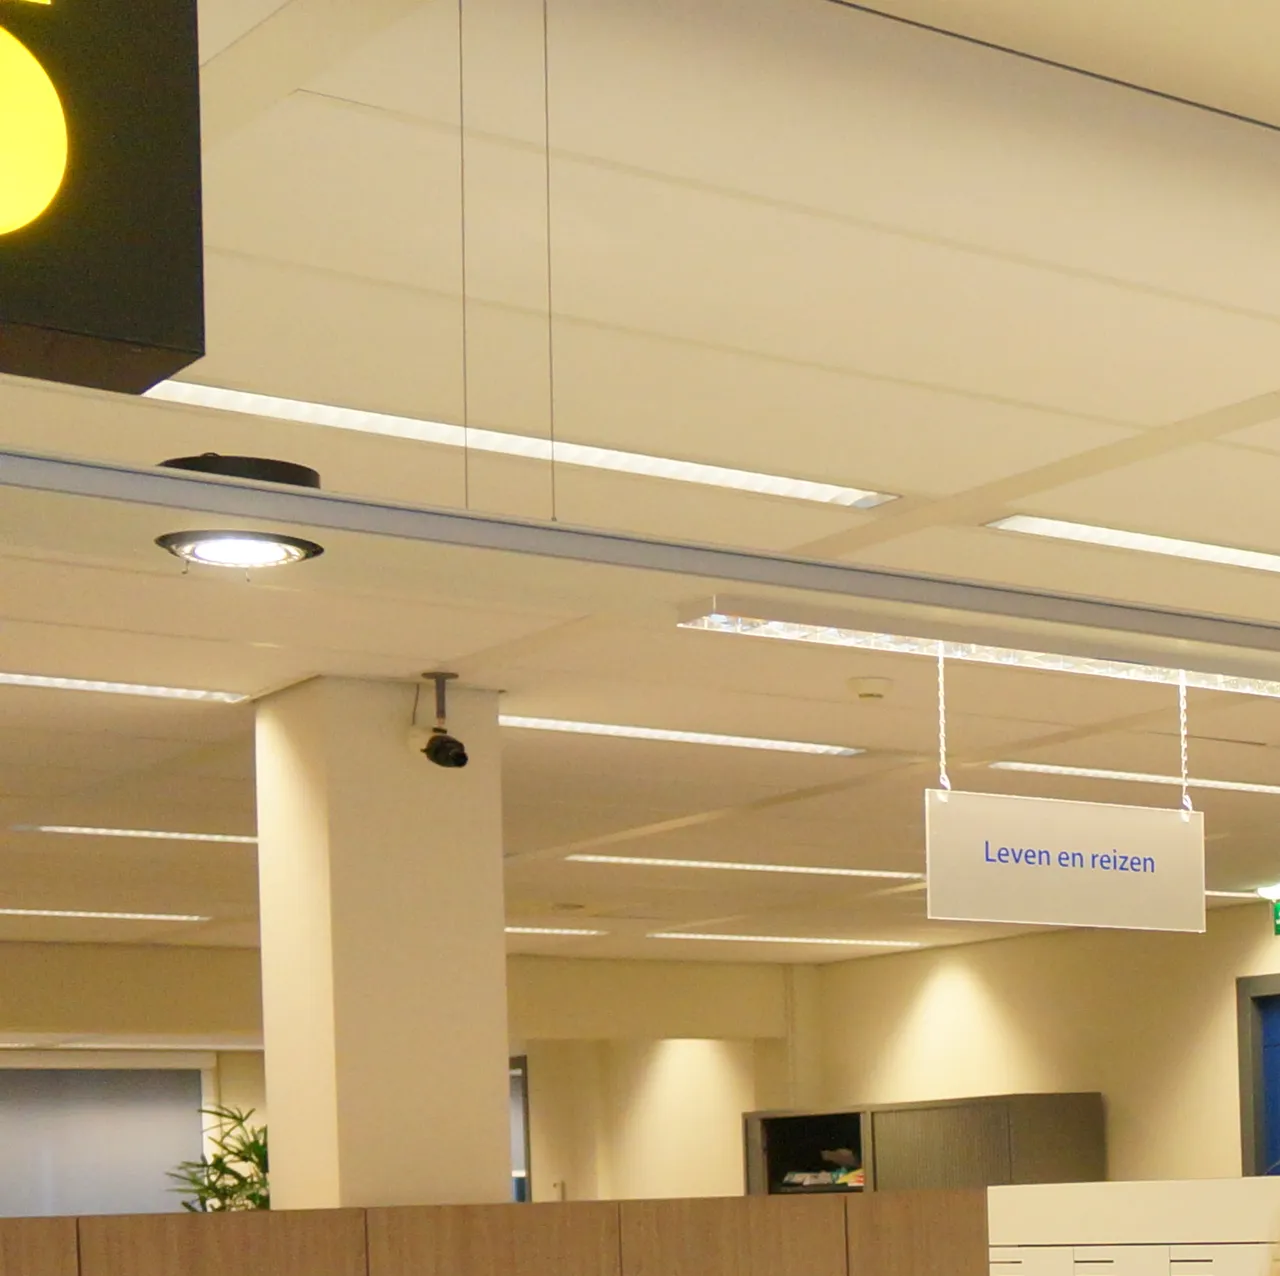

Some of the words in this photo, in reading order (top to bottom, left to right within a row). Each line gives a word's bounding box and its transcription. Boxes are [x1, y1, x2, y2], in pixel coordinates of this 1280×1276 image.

[984, 840, 1051, 866] Leven
[1057, 849, 1084, 868] en
[1091, 849, 1156, 873] reizen
